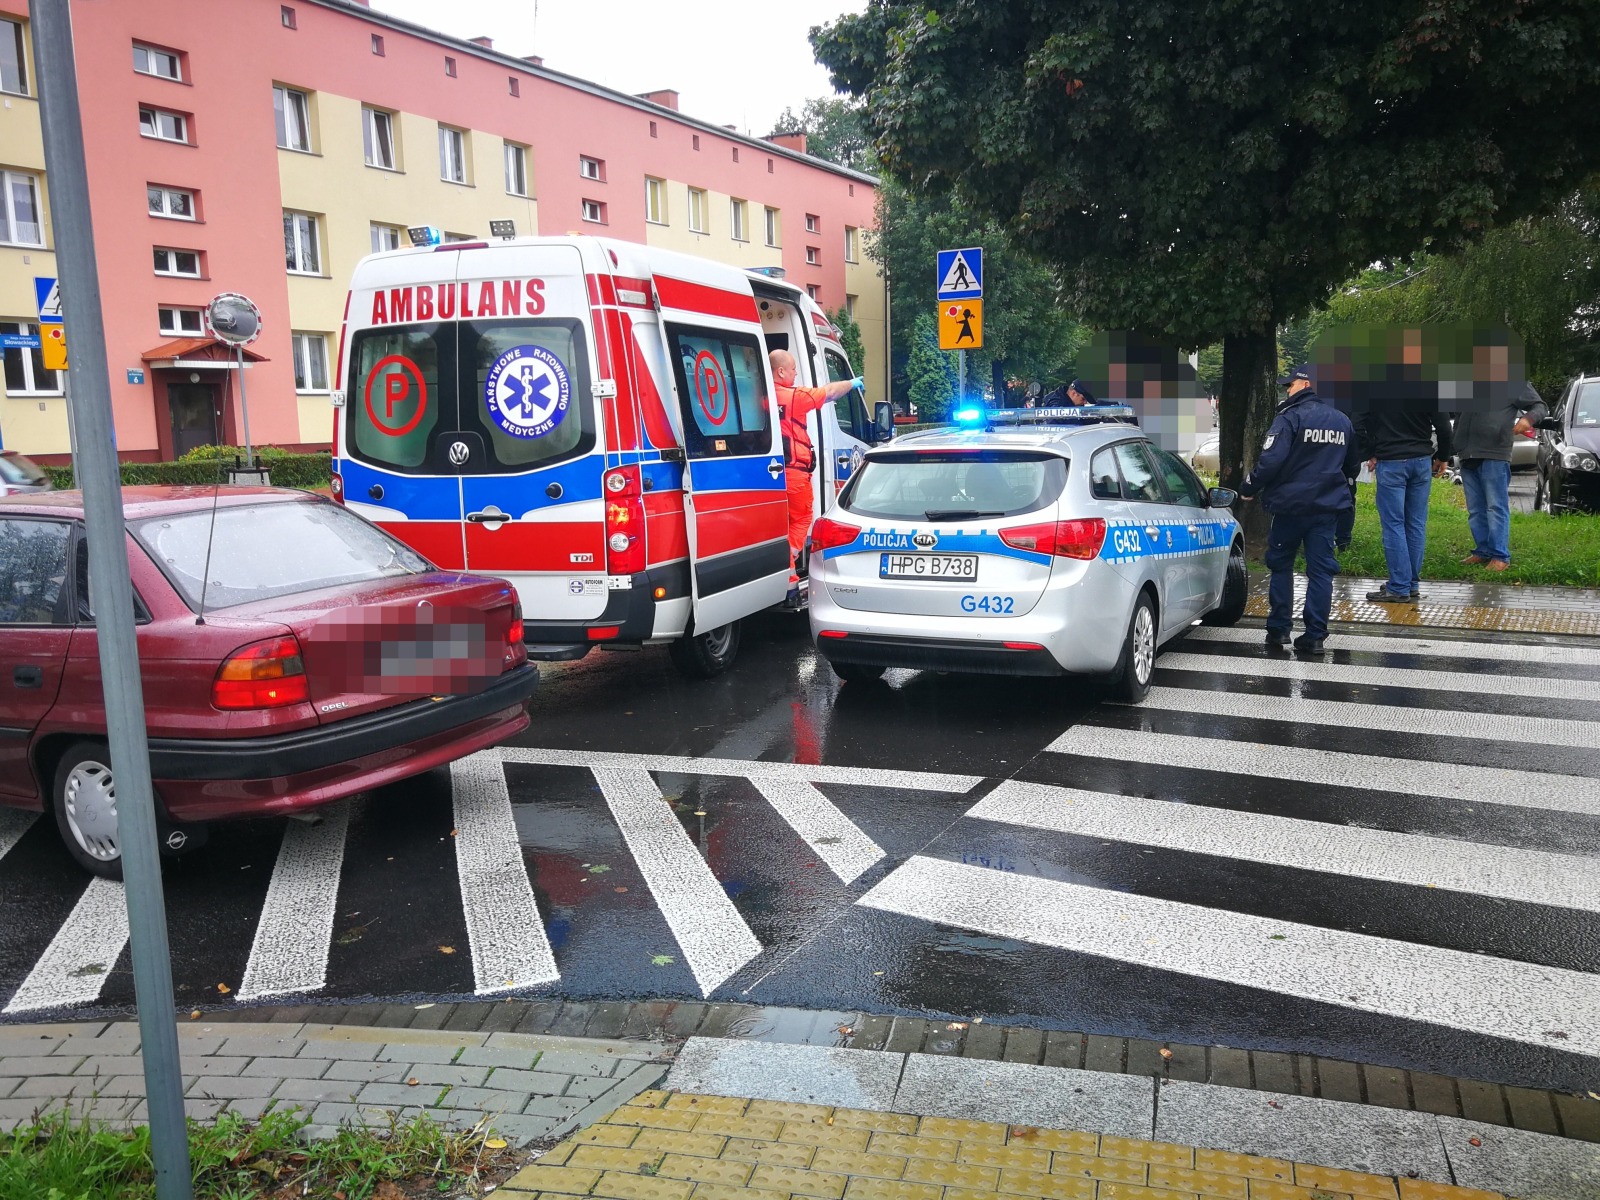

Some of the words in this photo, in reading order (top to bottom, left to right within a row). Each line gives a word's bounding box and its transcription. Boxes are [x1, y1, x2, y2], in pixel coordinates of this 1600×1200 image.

[372, 278, 546, 326] AMBULANS
[133, 376, 139, 384] 6
[487, 349, 521, 412] PAŃSTWOWE
[533, 348, 569, 411] RATOWNICTWO
[386, 372, 410, 418] P
[704, 368, 719, 410] P
[1036, 408, 1079, 417] POLICJA
[501, 419, 555, 436] MEDYCZNE
[1303, 429, 1345, 446] POLICJA
[863, 534, 909, 548] POLICJA
[916, 535, 933, 545] KIA
[1114, 530, 1142, 553] G432
[573, 554, 592, 562] TDI
[890, 556, 926, 574] HPG
[931, 557, 973, 575] B738
[960, 595, 1015, 614] G432
[321, 701, 349, 713] OPEL
